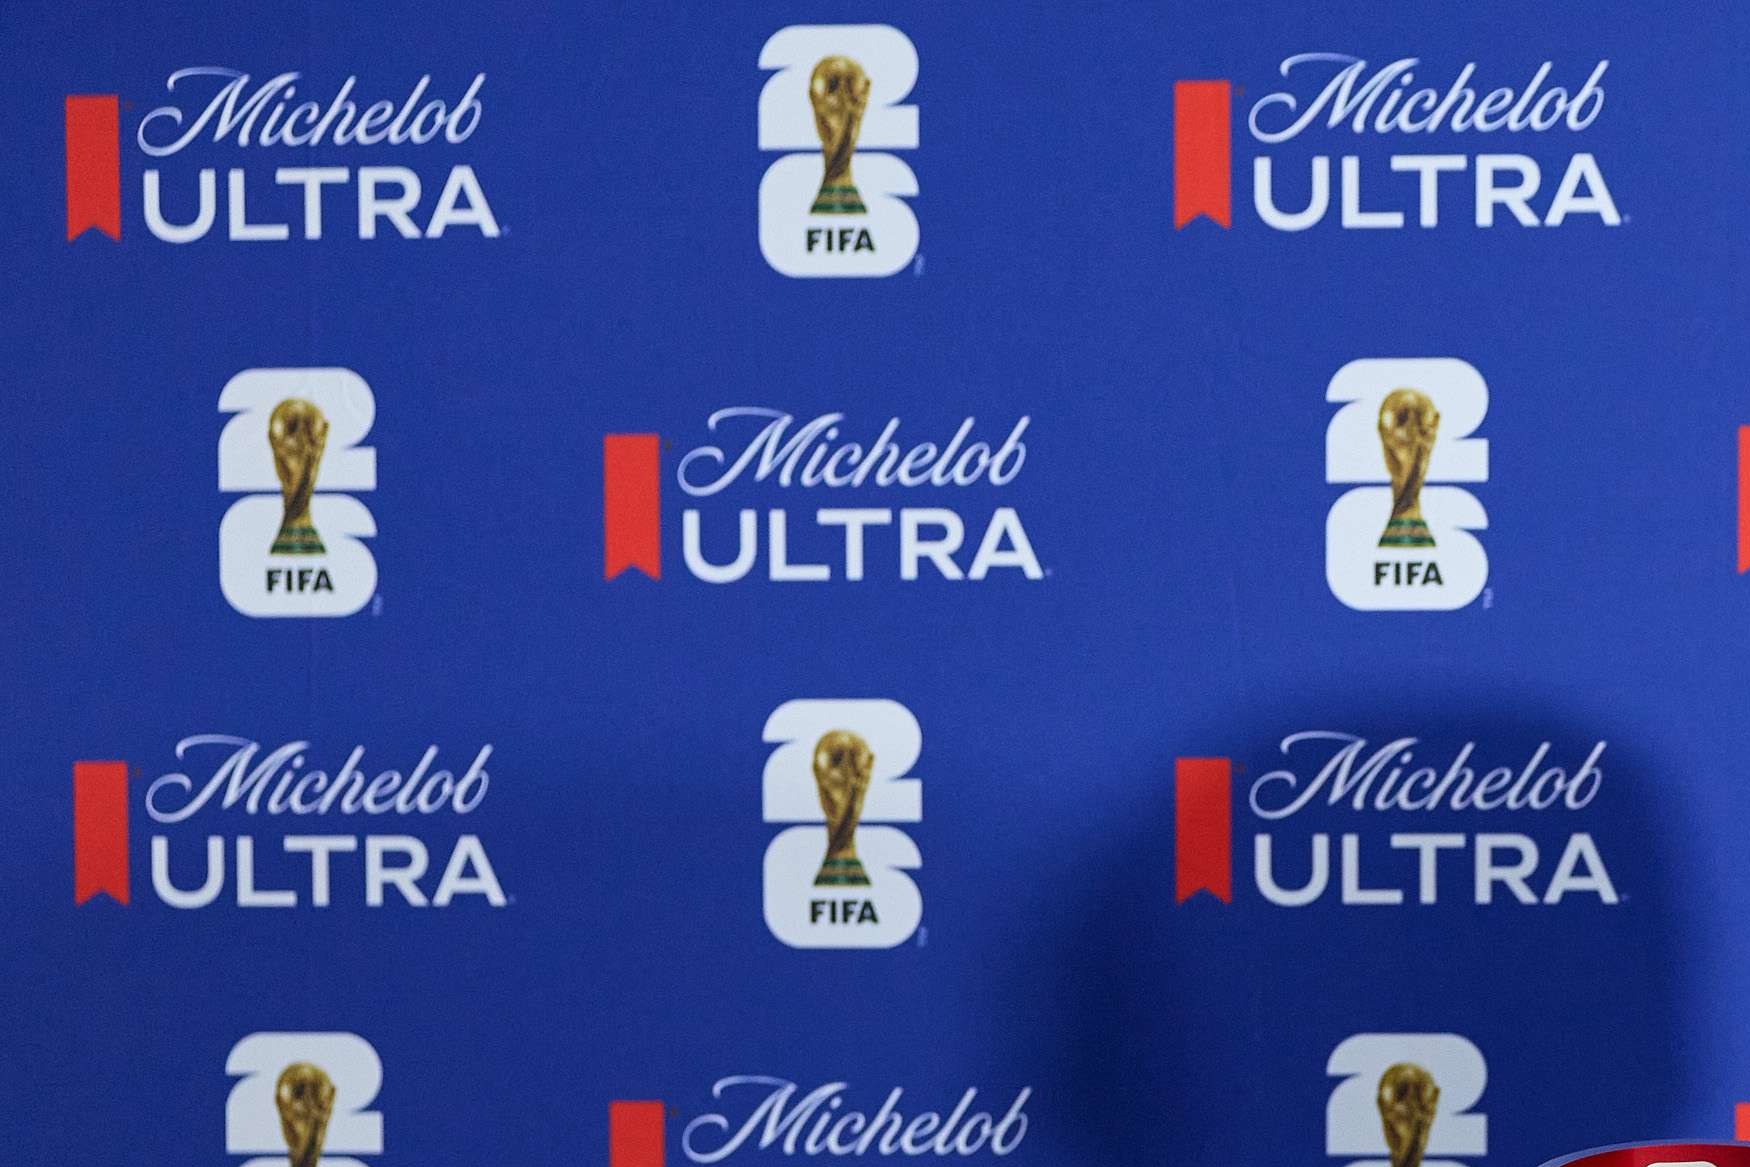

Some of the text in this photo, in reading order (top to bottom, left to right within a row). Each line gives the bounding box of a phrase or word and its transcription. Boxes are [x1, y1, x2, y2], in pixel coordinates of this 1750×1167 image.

[137, 67, 486, 157] Michelob
[1248, 52, 1609, 144] Michelob
[142, 164, 501, 244] ULTRA
[1253, 152, 1621, 232] ULTRA
[806, 228, 875, 253] FIFA
[677, 406, 1031, 497] Michelob
[266, 568, 334, 593] FIFA
[682, 507, 1044, 584] ULTRA
[1374, 561, 1444, 586] FIFA
[145, 734, 493, 823] Michelob
[1248, 730, 1607, 820] Michelob
[151, 834, 507, 909] ULTRA
[1254, 832, 1619, 907] ULTRA
[810, 899, 879, 924] FIFA
[682, 1075, 1031, 1164] Michelob
